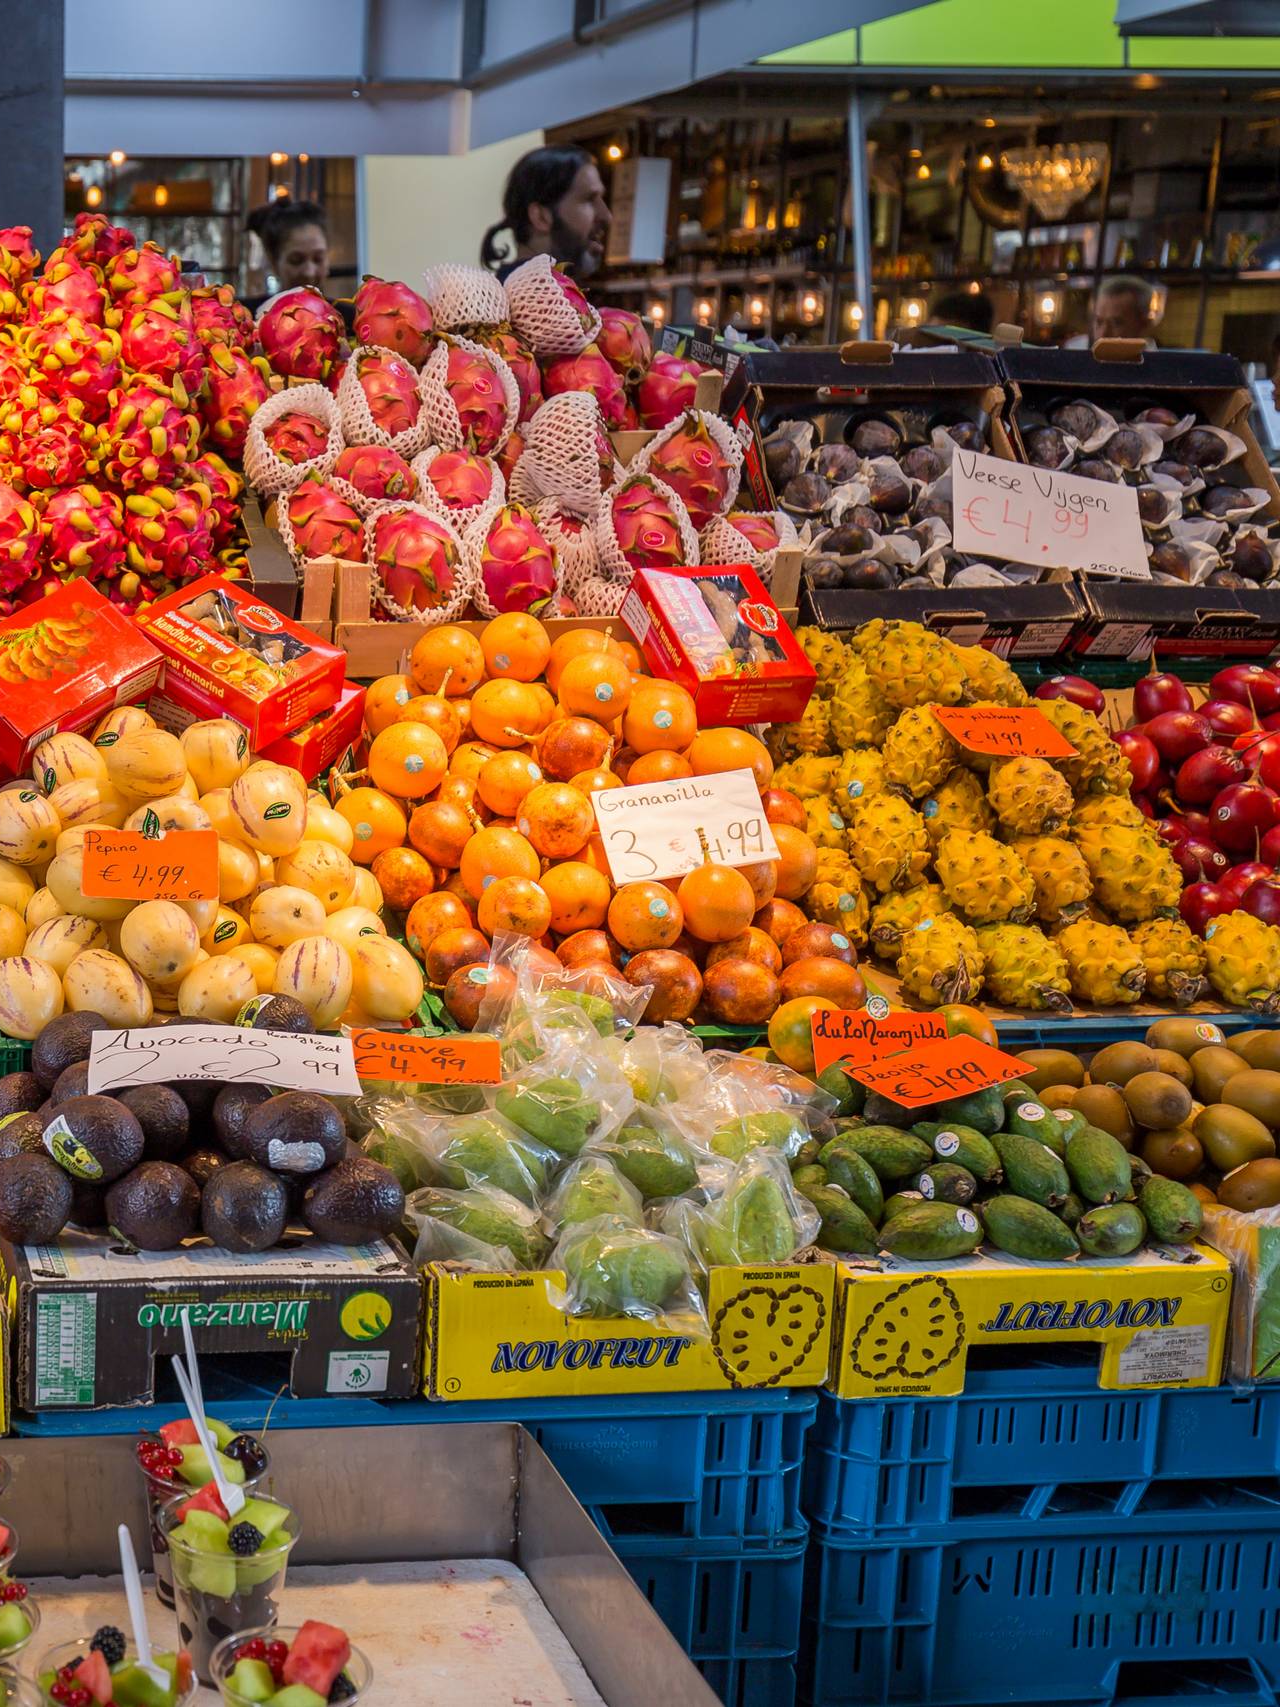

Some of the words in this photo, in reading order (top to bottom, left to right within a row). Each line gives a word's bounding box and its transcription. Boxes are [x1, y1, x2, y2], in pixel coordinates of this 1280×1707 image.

[958, 453, 1022, 493] Verse
[1032, 472, 1110, 514] Vijgen
[962, 496, 996, 536] €
[1090, 563, 1117, 574] 250
[152, 617, 207, 654] Namdhari's
[182, 663, 226, 699] tamarind
[84, 831, 138, 856] Pepino
[610, 830, 658, 878] 3
[98, 864, 122, 882] €
[133, 863, 185, 887] 4.99
[154, 892, 178, 900] 250
[188, 890, 204, 900] Gr
[95, 1030, 268, 1051] Avocado
[354, 1033, 456, 1057] Guave
[94, 1050, 170, 1088] 2
[198, 1060, 229, 1074] €
[355, 1055, 383, 1075] €
[390, 1056, 467, 1078] 4.99
[892, 1083, 933, 1099] €
[926, 1061, 989, 1092] 4.99
[473, 1280, 504, 1289] PRODUCIDO
[505, 1279, 513, 1288] EN
[742, 1271, 774, 1281] PRODUCED
[775, 1271, 783, 1279] IN
[783, 1271, 801, 1280] SPAIN
[138, 1300, 310, 1330] Manzano
[986, 1297, 1183, 1333] NOVOFRUT
[490, 1336, 692, 1374] NOVOFRUT
[874, 1385, 893, 1394] SPAIN
[901, 1384, 932, 1393] PRODUCED
